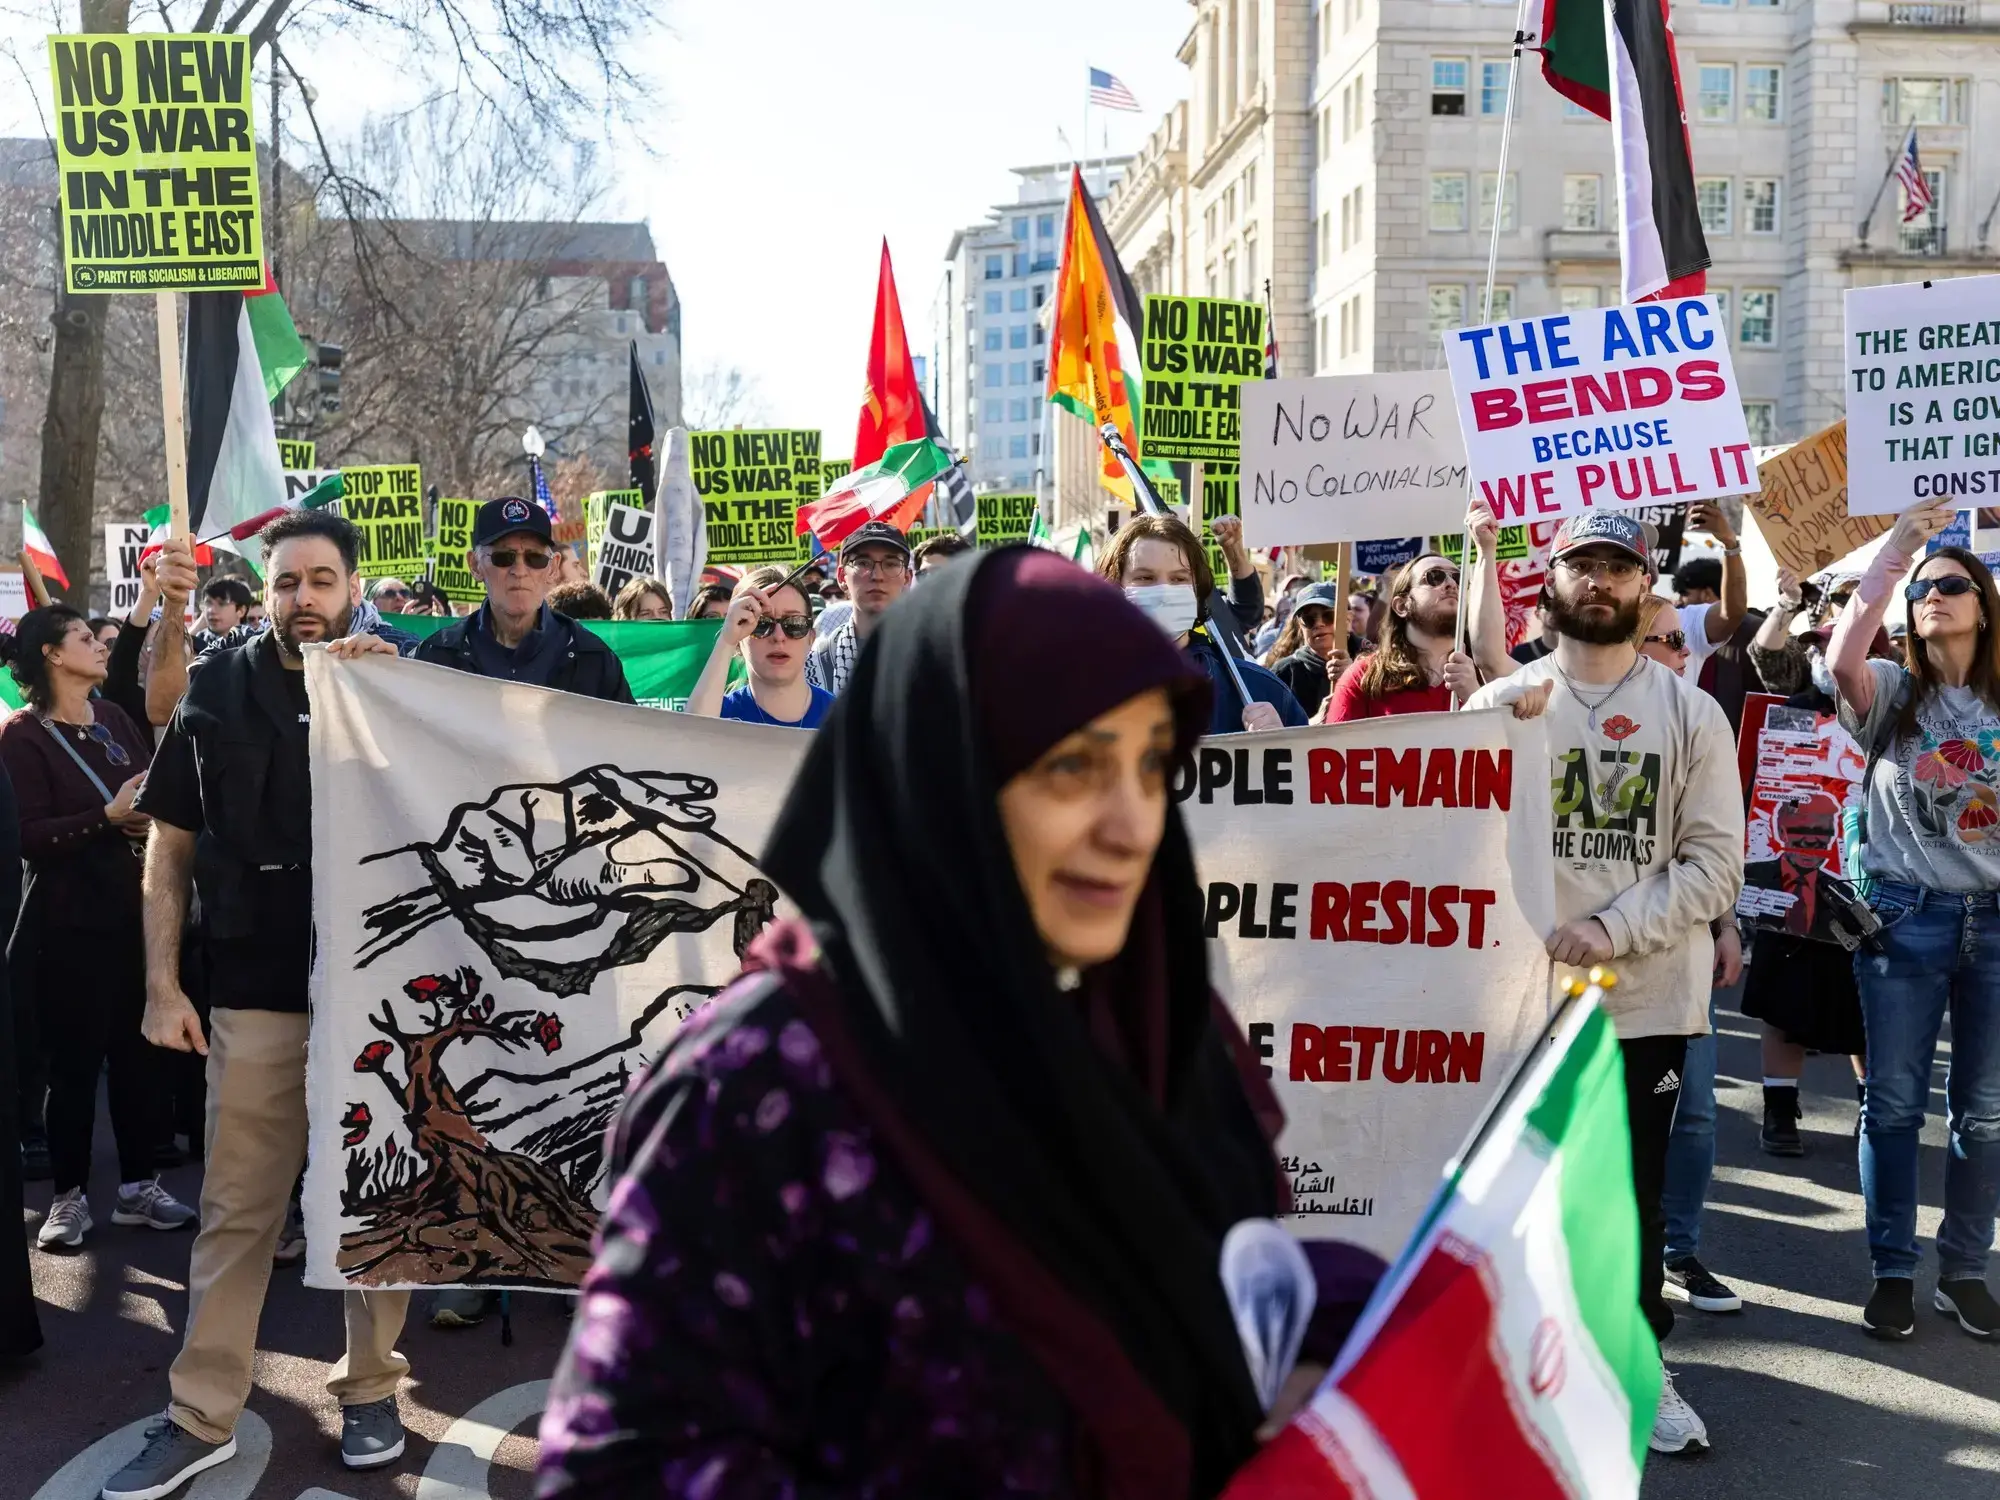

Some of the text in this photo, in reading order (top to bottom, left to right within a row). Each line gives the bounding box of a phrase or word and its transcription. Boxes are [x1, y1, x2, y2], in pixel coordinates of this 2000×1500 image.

[55, 40, 245, 106] NO NEW
[61, 108, 252, 156] US WAR
[66, 167, 253, 210] IN THE
[70, 210, 254, 259] MIDDLE EAST
[98, 270, 127, 284] PARTY
[130, 270, 148, 283] FOR
[148, 268, 196, 283] SOCIALISM
[198, 267, 206, 280] &
[207, 266, 258, 281] LIBERATION
[1148, 299, 1188, 342] NO
[1197, 302, 1262, 345] NEW
[1459, 300, 1714, 380] THE ARC
[1856, 321, 2000, 356] THE GREAT
[1146, 342, 1262, 376] US WAR
[1852, 358, 2000, 392] TO AMERIC
[1146, 380, 1184, 406] IN
[1470, 360, 1726, 432] BENDS
[1144, 408, 1212, 439] MIDDLE
[1217, 412, 1240, 441] EA
[1344, 394, 1435, 440] WAR
[1890, 402, 1914, 426] IS
[1925, 400, 1943, 423] A
[692, 433, 788, 468] NO NEW
[1158, 444, 1175, 454] PARTY
[1176, 446, 1188, 455] FOR
[1188, 446, 1220, 457] SOCIALISM
[1220, 448, 1224, 456] &
[1532, 418, 1672, 463] BECAUSE
[1884, 435, 1954, 462] THAT
[279, 444, 312, 470] EW
[344, 470, 417, 495] STOP THE
[694, 468, 792, 494] US WAR
[824, 464, 850, 482] STO
[1480, 443, 1750, 520] WE PULL IT
[1914, 470, 2000, 498] CONST
[1162, 482, 1178, 502] THE
[344, 496, 420, 520] WAR
[441, 502, 468, 528] NO
[705, 502, 728, 522] N
[732, 499, 793, 520] THE
[978, 497, 1036, 518] NO NEW
[440, 529, 466, 548] US
[758, 521, 794, 545] EAST
[979, 520, 999, 534] US
[357, 524, 372, 562] N
[376, 522, 423, 562] IRAN!
[438, 552, 464, 569] IN
[600, 542, 654, 575] HANDS
[711, 553, 726, 562] PARTY
[728, 552, 738, 562] FOR
[1364, 551, 1414, 566] ANSWER!
[1308, 748, 1512, 812] REMAIN
[1552, 748, 1661, 836] AZA
[1553, 832, 1655, 866] HE COMPASS
[1199, 882, 1298, 940] PLE
[1290, 1023, 1484, 1084] RETURN
[1280, 1156, 1323, 1178] حركة
[1294, 1176, 1335, 1194] الشبا
